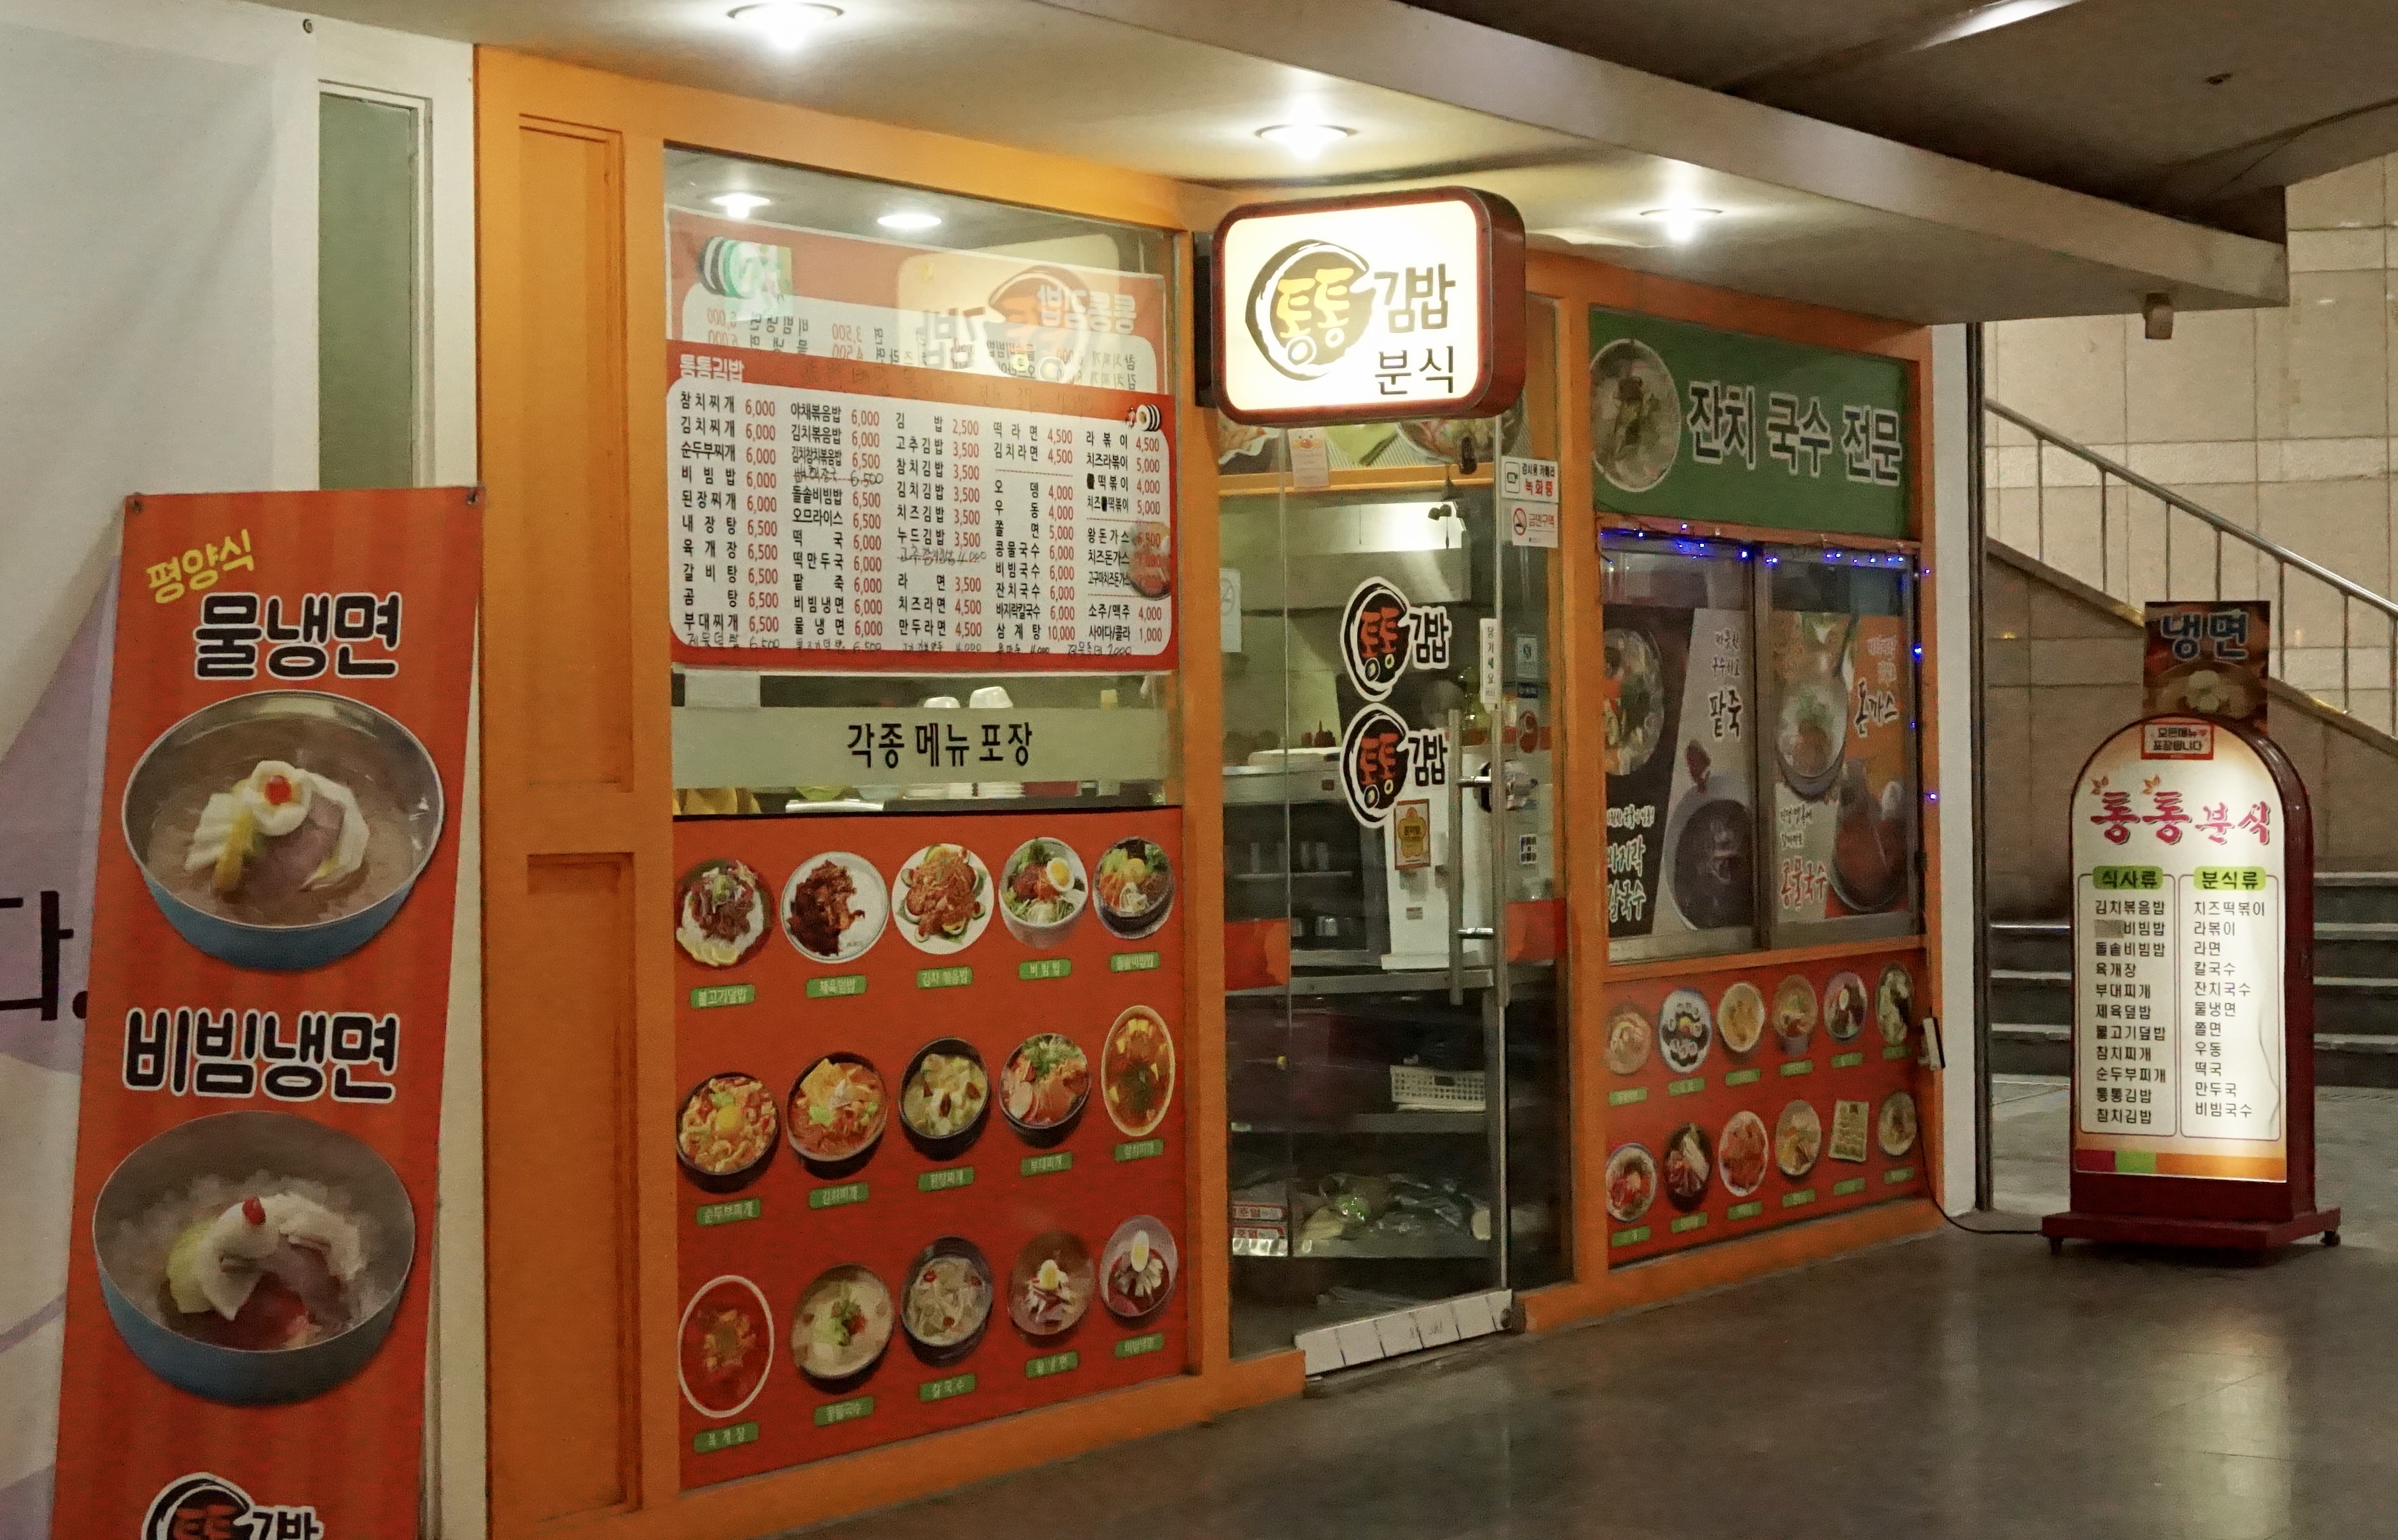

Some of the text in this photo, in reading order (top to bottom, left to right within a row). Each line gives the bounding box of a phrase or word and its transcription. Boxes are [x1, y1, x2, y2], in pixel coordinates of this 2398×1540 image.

[1374, 264, 1456, 333] 김밥
[1374, 346, 1454, 394] 분식
[680, 391, 775, 417] 참치찌개 6,000
[791, 402, 880, 427] 야채볶음밥 6,000
[895, 412, 979, 436] 김밥 2,500
[681, 417, 776, 441] 김치찌개 6,000
[792, 424, 880, 449] 김치볶음밥 6,000
[994, 422, 1072, 445] 떡라면 4,500
[1686, 380, 1902, 486] 잔치 국수 전문
[895, 434, 979, 458] 고추김밥 3,500
[1086, 430, 1160, 453] 라볶이 4,500
[681, 441, 776, 464] 순두부찌개 6,000
[792, 447, 880, 470] 김치참치볶음밥 6,500
[994, 443, 1072, 464] 김치라면 4,500
[896, 457, 979, 481] 참치김밥 3,500
[1087, 453, 1160, 474] 치즈라볶이 5,000
[681, 466, 776, 489] 비빔밥 6,000
[1086, 473, 1160, 495] 떡볶이 4,000
[1526, 478, 1553, 497] 녹화중
[792, 485, 881, 508] 돌솥비빔밥 6,500
[897, 480, 980, 503] 김치김밥 3,500
[995, 480, 1073, 500] 오뎅 4,000
[682, 490, 777, 513] 된장찌개 6,000
[995, 500, 1073, 521] 우동 4,000
[1087, 494, 1160, 515] 치즈떡볶이 5,000
[792, 508, 881, 530] 오므라이스 6,500
[897, 503, 980, 526] 치즈김밥 3,500
[1528, 513, 1555, 528] 금연구역
[682, 515, 777, 537] 내장탕 6,500
[995, 520, 1074, 540] 쫄면 5,000
[793, 530, 881, 551] 떡국 6,000
[897, 528, 981, 548] 누드김밥 3,500
[1088, 528, 1129, 545] 왕돈가스
[683, 540, 778, 560] 육개장 6,500
[996, 541, 1040, 558] 콩물국수
[1049, 545, 1074, 561] 6,000
[1088, 549, 1130, 567] 치즈돈가스
[146, 529, 254, 604] 평양식
[793, 552, 844, 570] 떡만두국
[854, 556, 881, 573] 6,000
[996, 562, 1074, 581] 비빔국수 6,000
[683, 564, 778, 585] 갈비탕 6,500
[793, 573, 882, 594] 팥죽 6,000
[898, 573, 981, 593] 라면 3,500
[683, 588, 778, 609] 곰탕 6,500
[996, 582, 1074, 601] 잔치국수 6,000
[794, 596, 882, 615] 비빔냉면 6,000
[898, 596, 981, 616] 치즈라면 4,500
[996, 603, 1075, 621] 바지락칼국수 6,000
[1088, 603, 1162, 621] 소주/맥주 4,000
[683, 612, 779, 633] 부대찌개 6,500
[794, 617, 882, 636] 물냉면 6,000
[899, 618, 982, 638] 만두라면 4,500
[996, 624, 1075, 641] 삼계탕 10,000
[193, 591, 402, 680] 물냉면
[1089, 624, 1162, 642] 사이다/콜라 1,000
[1409, 611, 1449, 663] 김밥
[2160, 610, 2249, 661] 냉면
[847, 722, 1033, 768] 각종 메뉴 포장
[1408, 735, 1448, 786] 김밥
[2102, 869, 2158, 889] 식사류
[2202, 870, 2259, 889] 분식류
[2095, 900, 2165, 916] 김치볶음밥
[2194, 902, 2265, 916] 치즈떡볶이
[2194, 922, 2235, 937] 라볶이
[2095, 942, 2165, 957] 돌솥비빔밥
[2194, 941, 2221, 956] 라면
[2095, 963, 2137, 977] 육개장
[2194, 962, 2236, 976] 칼국수
[2096, 983, 2151, 998] 부대찌개
[2194, 982, 2251, 996] 잔치국수
[2096, 1004, 2152, 1019] 제육덮밥
[2194, 1002, 2236, 1017] 물냉면
[2096, 1025, 2166, 1041] 불고기덮밥
[2195, 1022, 2222, 1037] 쫄면
[122, 1006, 399, 1103] 비빔냉면
[2097, 1046, 2152, 1062] 참치찌개
[2195, 1043, 2222, 1057] 우동
[2097, 1068, 2166, 1083] 순두부찌개
[2195, 1062, 2222, 1078] 떡국
[2097, 1087, 2152, 1103] 통통김밥
[2195, 1082, 2237, 1097] 만두국
[2097, 1109, 2152, 1124] 참치김밥
[2195, 1103, 2253, 1117] 비빔국수
